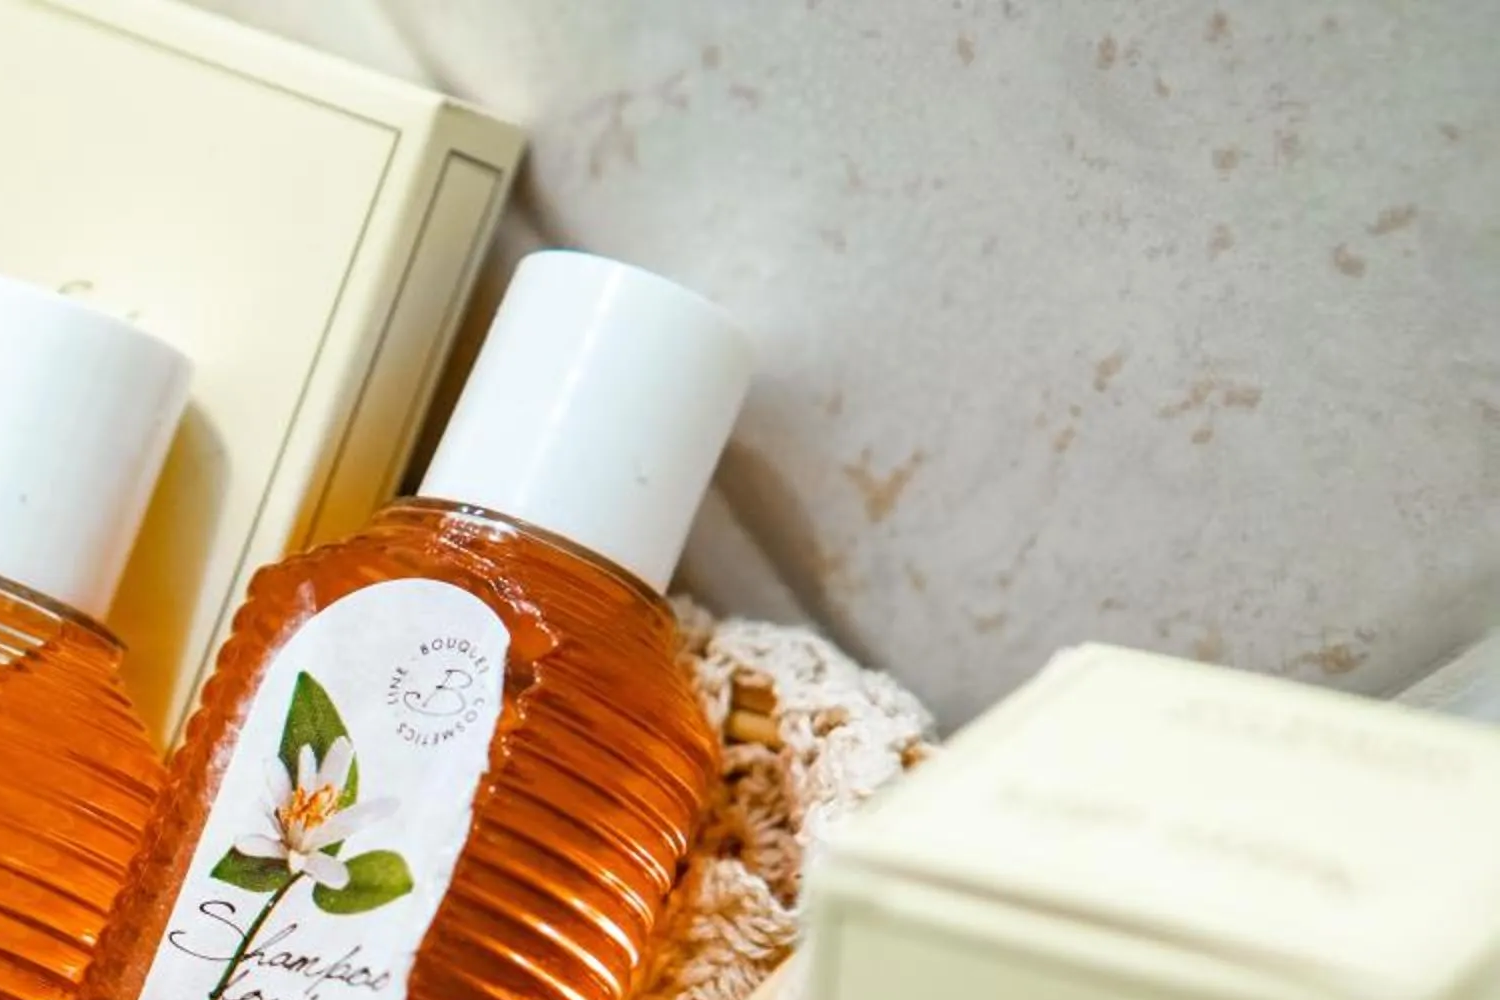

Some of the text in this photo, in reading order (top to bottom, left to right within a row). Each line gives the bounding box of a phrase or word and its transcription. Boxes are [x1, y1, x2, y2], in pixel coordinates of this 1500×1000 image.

[387, 638, 490, 745] BOUQUET COSMETICS LINE
[167, 900, 392, 994] Shampoo
